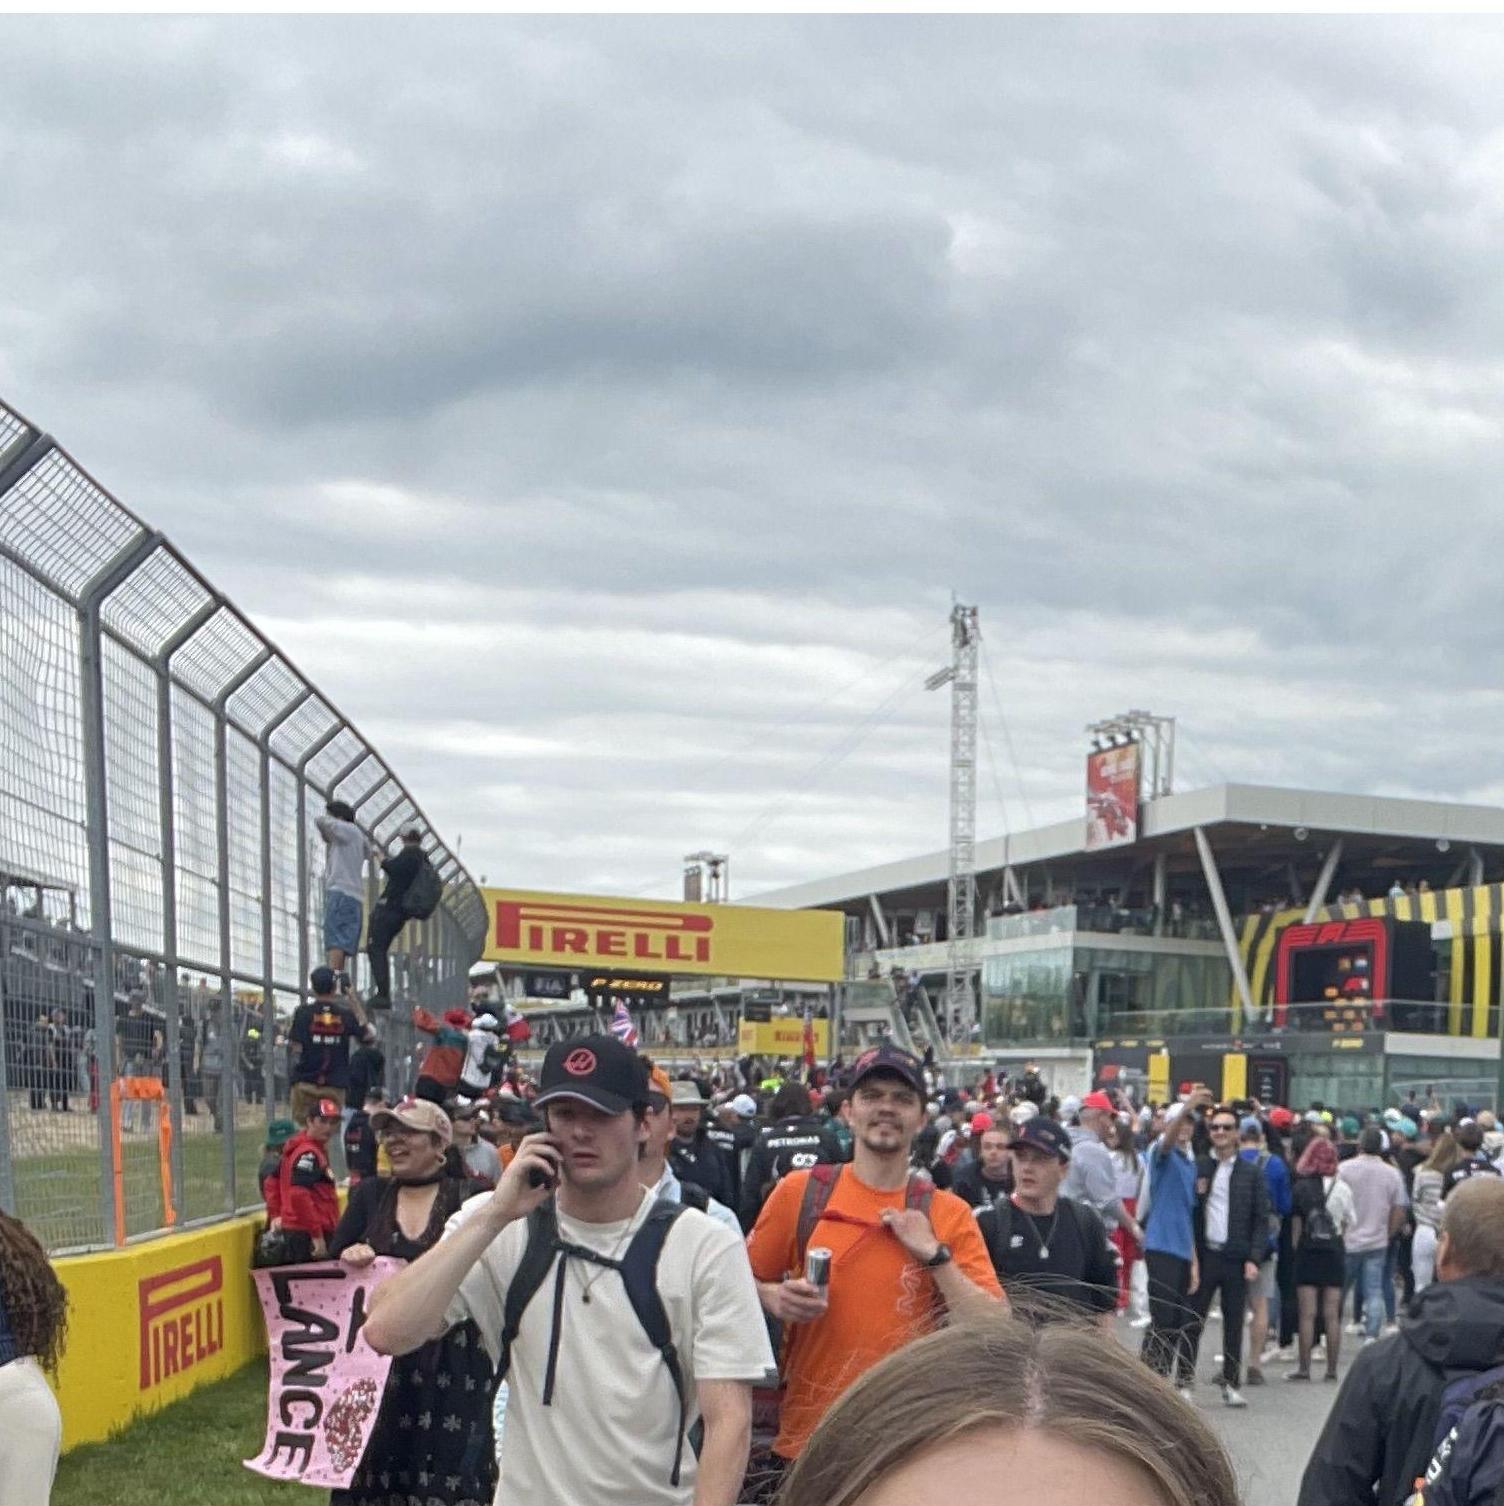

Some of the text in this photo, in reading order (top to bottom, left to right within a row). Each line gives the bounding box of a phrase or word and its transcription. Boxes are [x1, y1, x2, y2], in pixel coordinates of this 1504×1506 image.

[495, 899, 714, 963] PIRELLI
[138, 1254, 223, 1392] PIRELLI
[265, 1269, 347, 1474] LANCE
